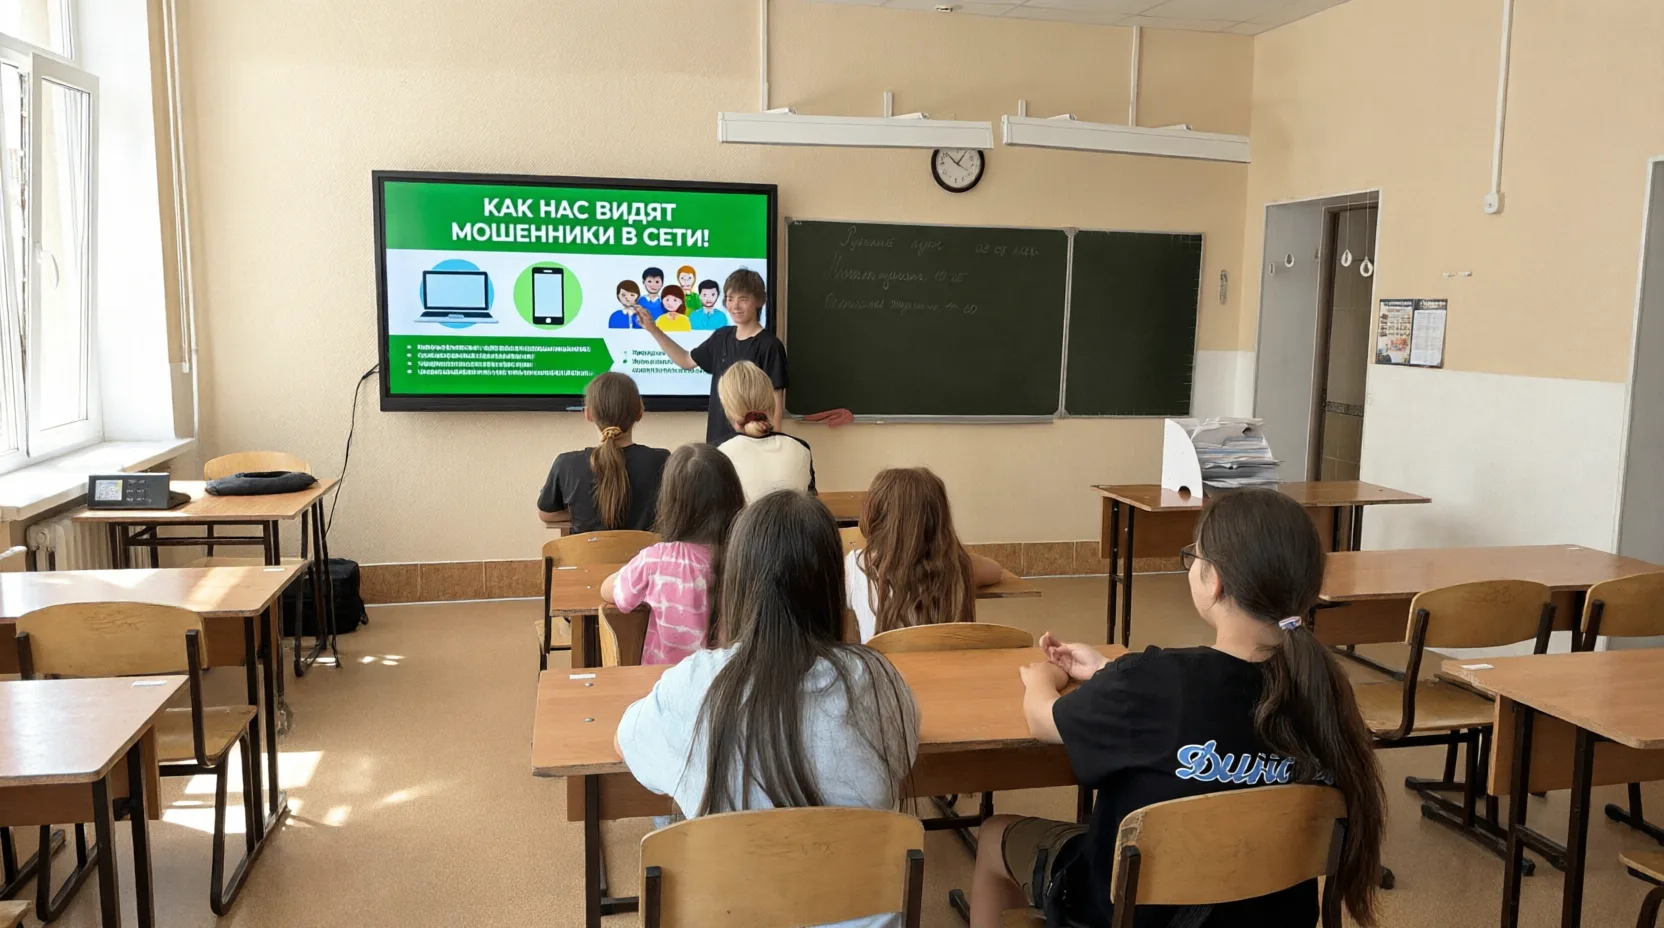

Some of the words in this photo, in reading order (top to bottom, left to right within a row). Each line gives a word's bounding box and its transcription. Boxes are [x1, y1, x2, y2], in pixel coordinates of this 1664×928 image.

[483, 197, 533, 217] КАК
[539, 199, 589, 219] НАС
[595, 201, 676, 225] ВИДЯТ
[451, 222, 615, 245] МОШЕННИКИ
[621, 226, 638, 246] В
[642, 227, 709, 248] СЕТИ!
